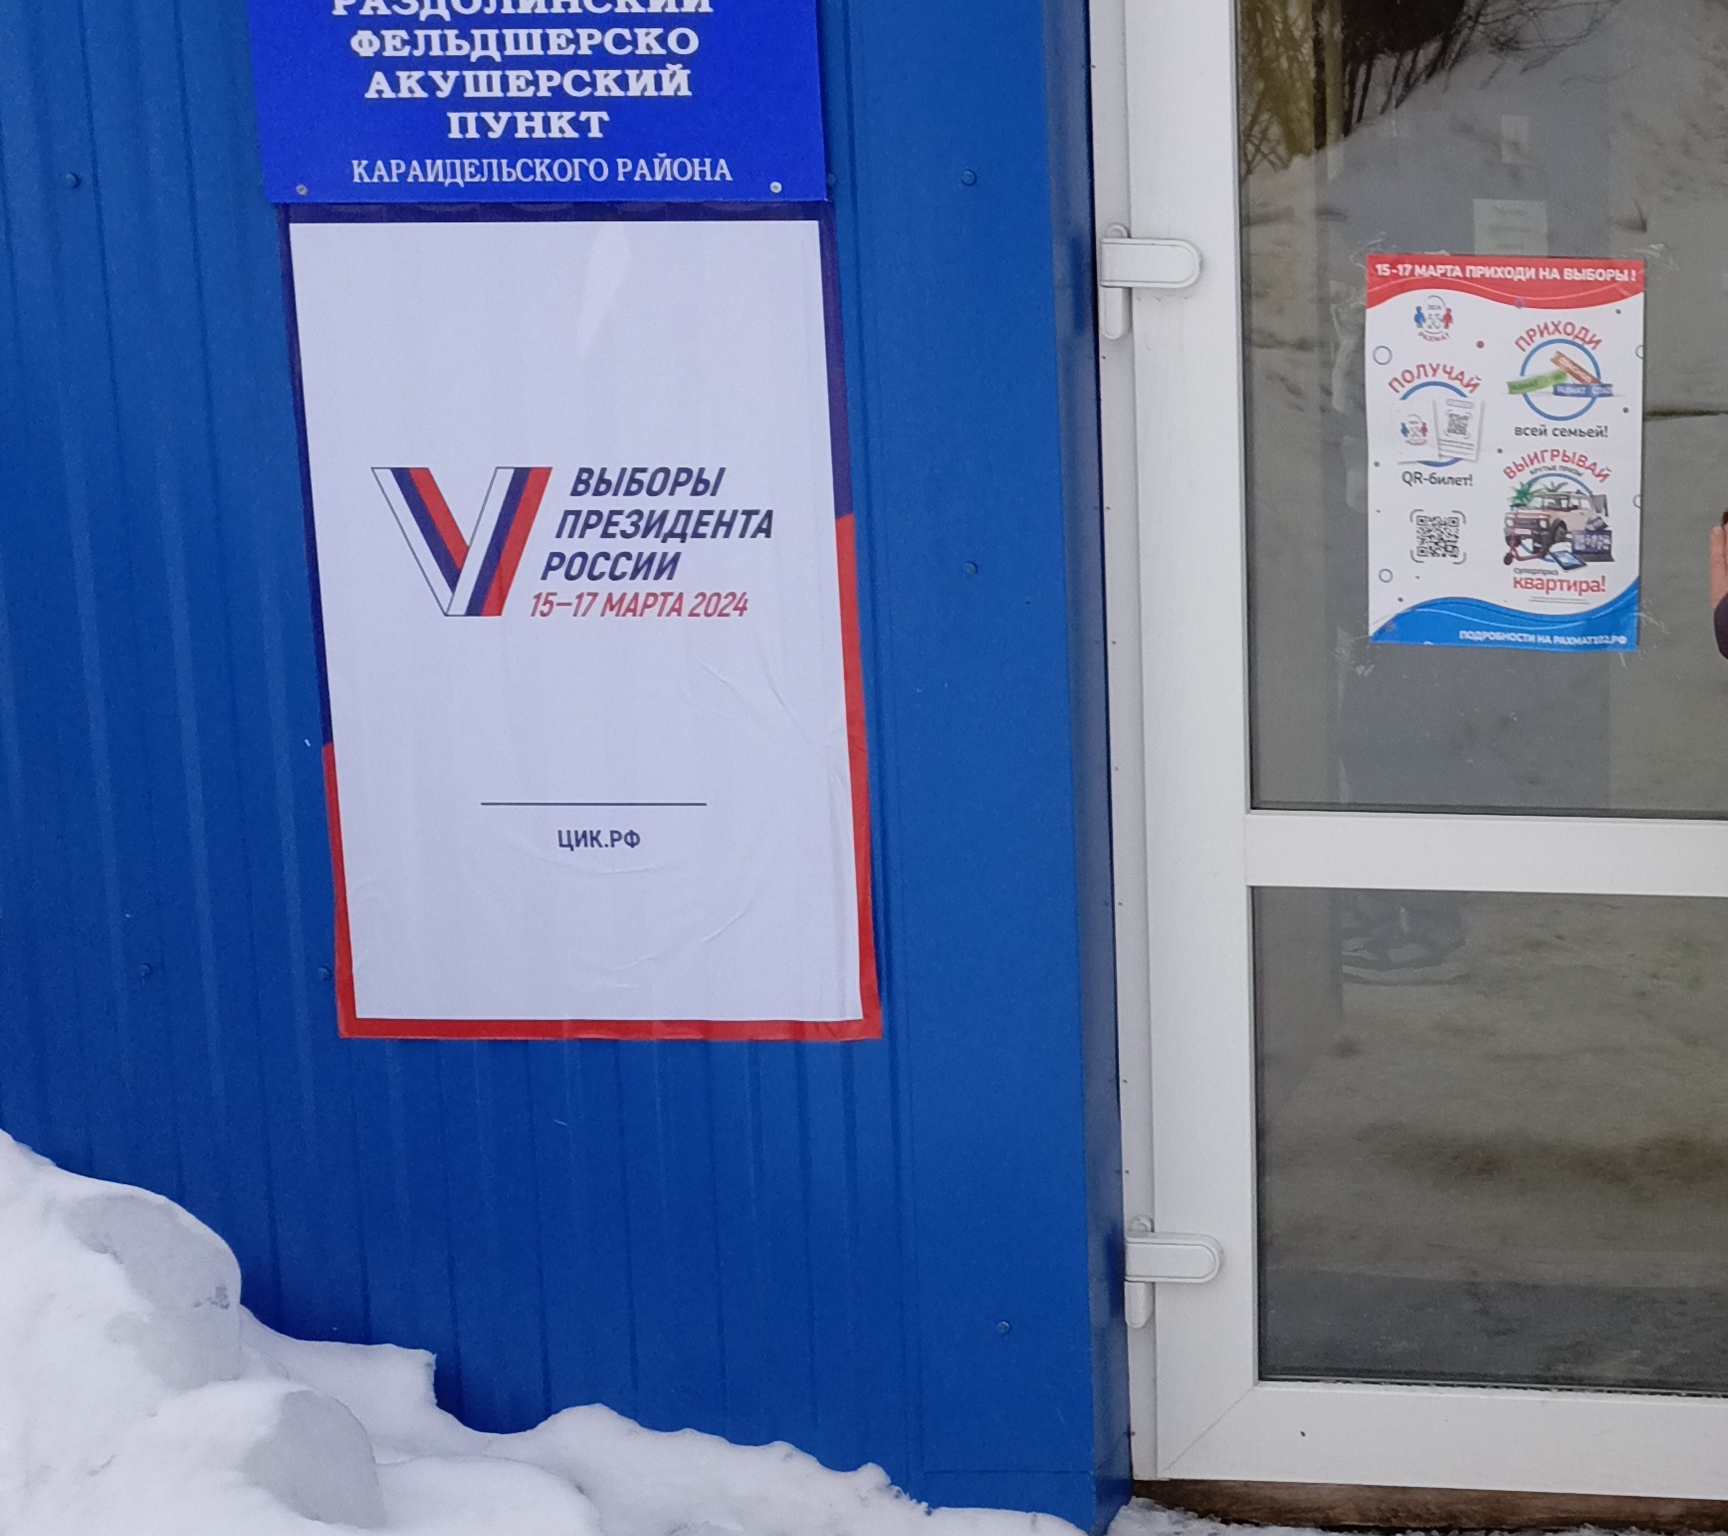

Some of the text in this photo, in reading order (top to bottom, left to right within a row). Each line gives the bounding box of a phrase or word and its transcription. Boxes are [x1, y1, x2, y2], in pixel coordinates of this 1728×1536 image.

[350, 27, 699, 62] ФЕЛЬДШЕРСКО
[364, 63, 693, 99] АКУШЕРСКИЙ
[447, 111, 610, 139] ПУНКТ
[352, 153, 733, 188] КАРАИДЕЛЬСКОГО РАЙОНА
[1414, 264, 1462, 277] МАРТА
[1465, 265, 1535, 280] ПРИХОДИ
[1538, 267, 1560, 279] НА
[1514, 320, 1603, 352] ПРИХОДИ
[1388, 362, 1482, 394] ПОЛУЧАЙ
[1514, 424, 1547, 436] всей
[569, 466, 727, 497] ВЫБОРЫ
[1503, 448, 1613, 483] ВЫИГРЫВАЙ
[555, 508, 774, 544] ПРЕЗИДЕНТА
[540, 550, 682, 582] РОССИИ
[1513, 575, 1606, 596] квартира!
[600, 591, 684, 617] МАРТА
[687, 591, 749, 617] 2024
[557, 829, 640, 851] ЦИК.РФ
